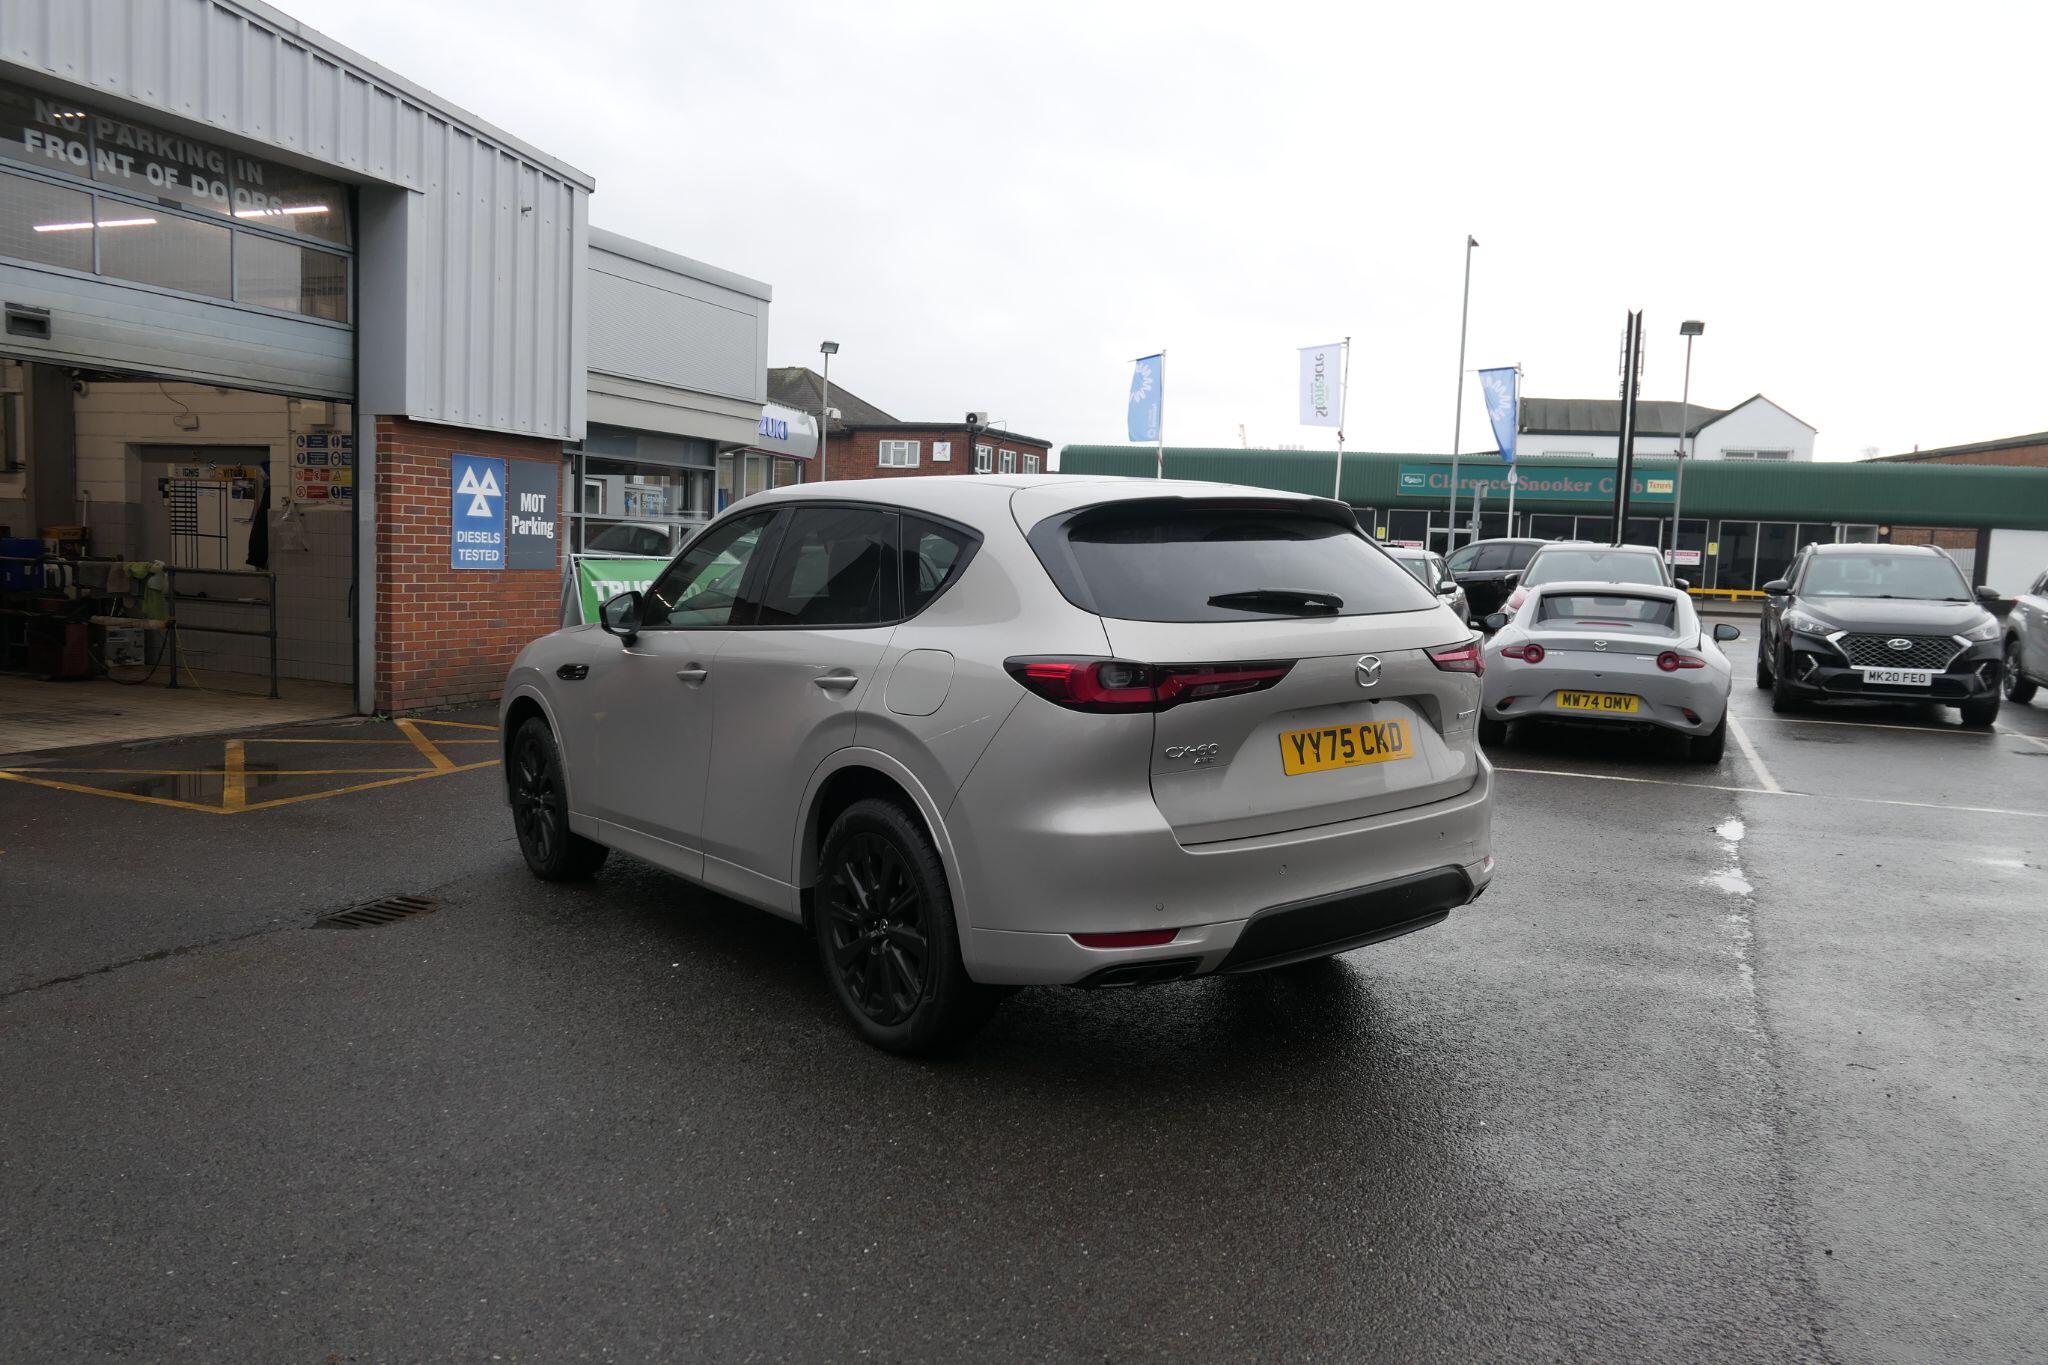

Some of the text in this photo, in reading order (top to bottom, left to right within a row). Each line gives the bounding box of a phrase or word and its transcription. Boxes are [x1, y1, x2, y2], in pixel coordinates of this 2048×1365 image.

[35, 99, 264, 186] NO PARKING IN
[23, 127, 135, 179] FRONT
[146, 162, 179, 190] OF
[1517, 476, 1592, 493] Snooker
[1599, 477, 1643, 494] Cb
[520, 492, 546, 513] MOT
[457, 530, 501, 543] DIESELS
[511, 515, 555, 539] Parking
[458, 549, 500, 561] TESTED
[1868, 671, 1926, 683] MK20 FEO
[1562, 692, 1632, 711] MW74 OMV
[1165, 743, 1219, 758] CX-60
[1291, 721, 1403, 766] YY75 CKD
